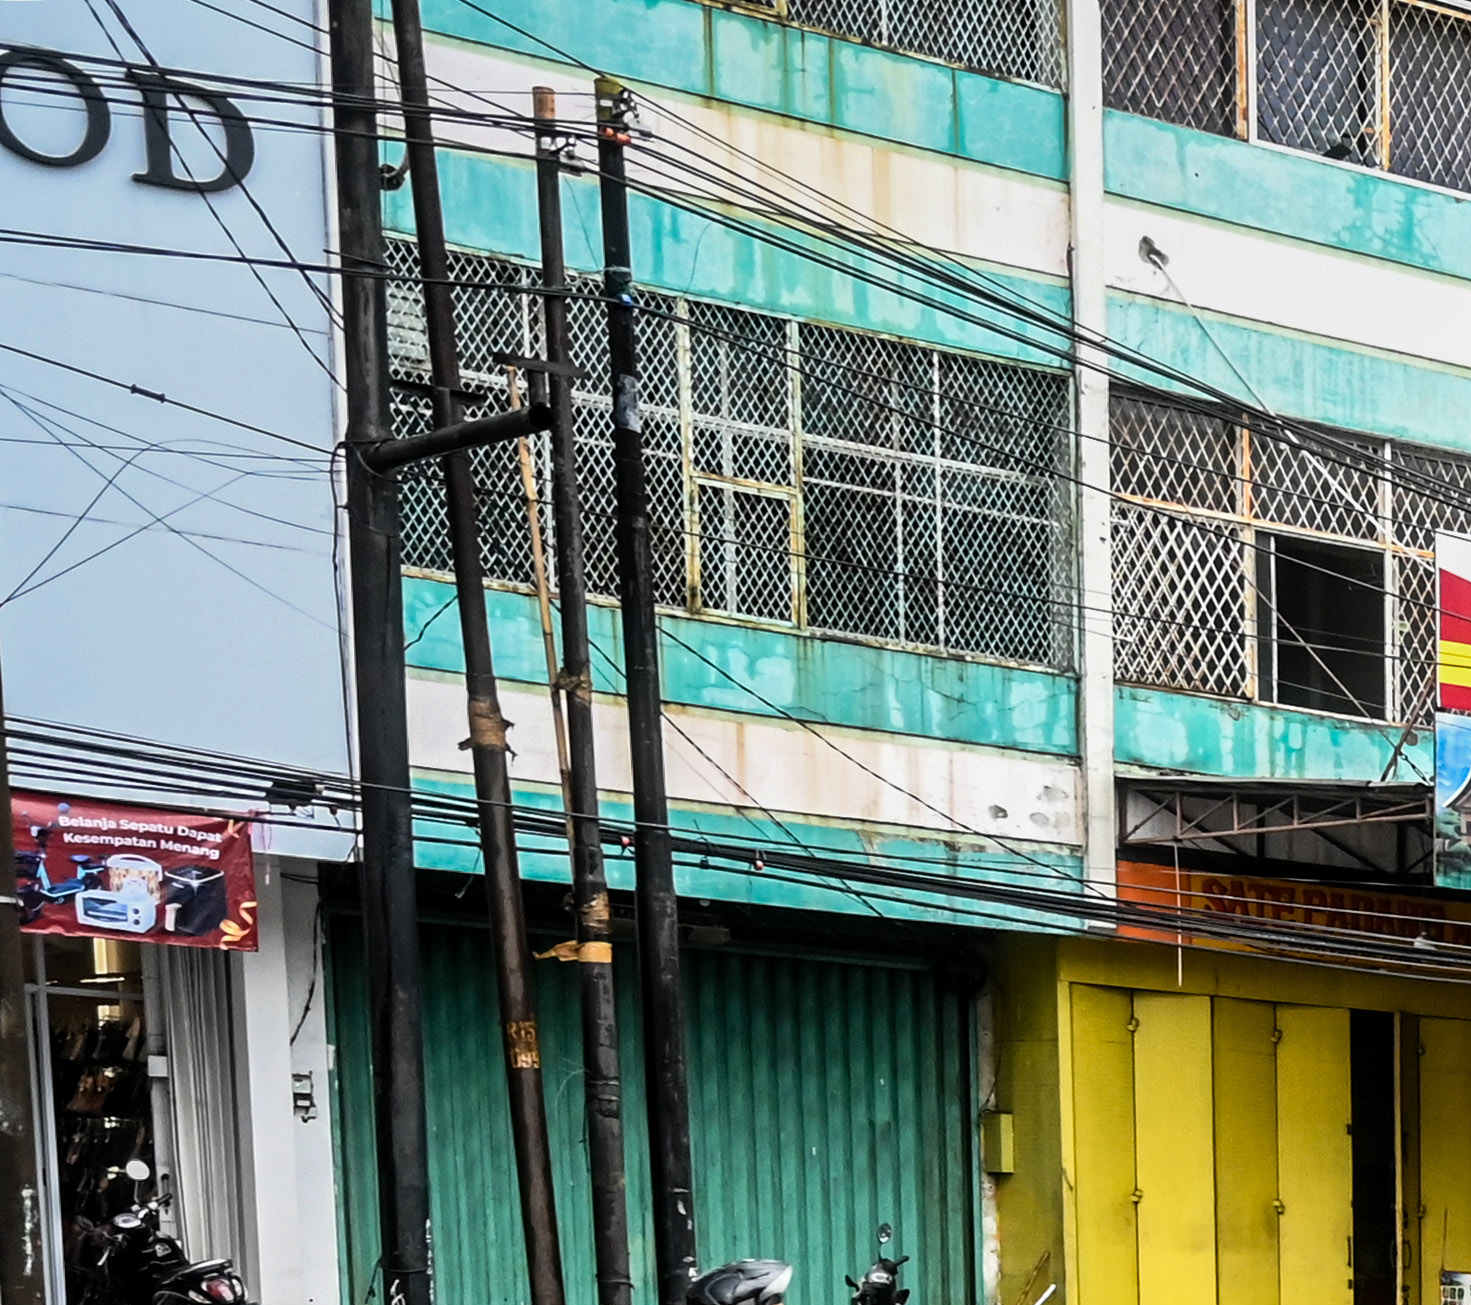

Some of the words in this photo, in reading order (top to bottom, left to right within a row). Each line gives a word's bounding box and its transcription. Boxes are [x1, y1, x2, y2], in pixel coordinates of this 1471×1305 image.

[58, 815, 118, 831] Belanja
[120, 819, 173, 835] Sepatu
[177, 825, 223, 844] Dapat
[63, 832, 157, 849] Kesempatan
[160, 840, 220, 860] Menang
